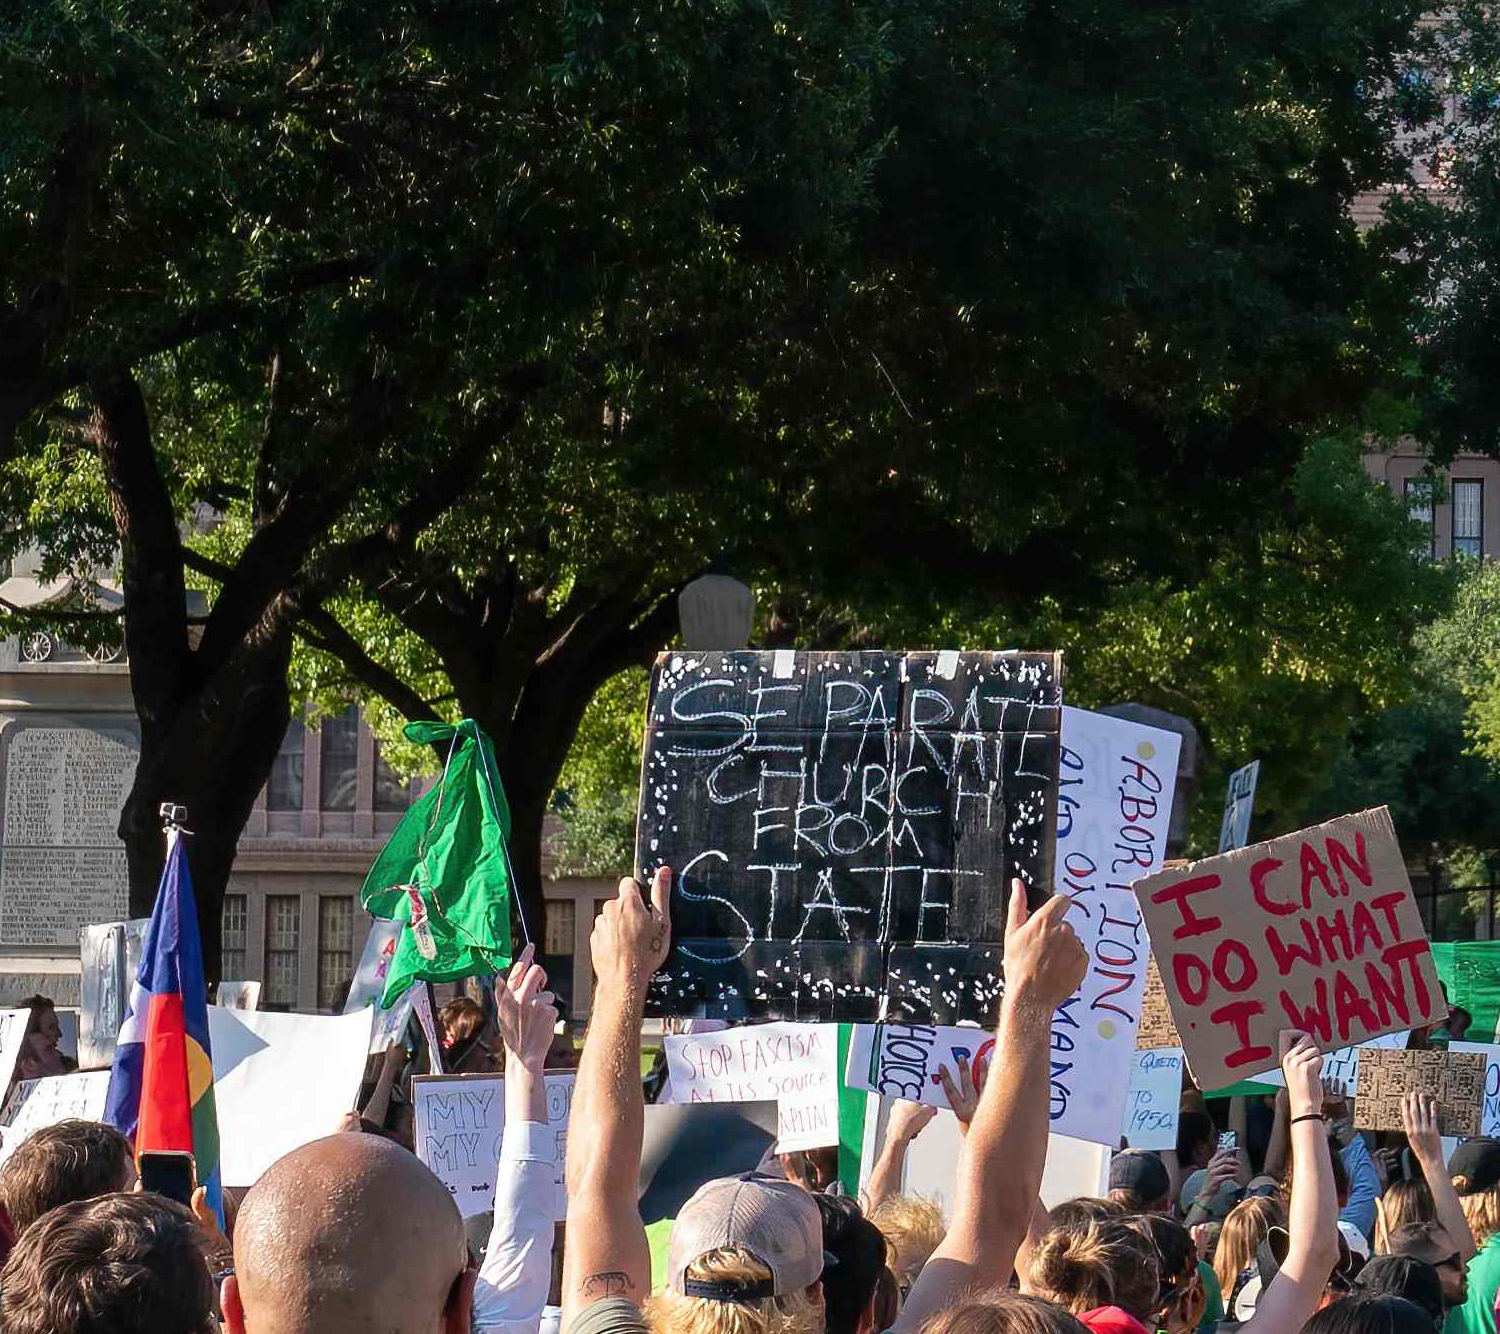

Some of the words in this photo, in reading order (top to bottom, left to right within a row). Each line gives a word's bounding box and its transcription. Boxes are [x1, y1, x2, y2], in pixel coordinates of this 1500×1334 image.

[667, 676, 1060, 789] SEPARATE
[706, 754, 998, 828] CHURCH
[753, 804, 924, 858] FROM
[676, 850, 984, 964] STATE
[1151, 874, 1221, 940] I
[1250, 831, 1372, 916] CAN
[1172, 939, 1258, 1006] DO
[1265, 891, 1406, 976] WHAT
[1210, 1000, 1272, 1067] I
[1279, 940, 1431, 1043] WANT
[682, 1043, 732, 1080] STOP
[739, 1032, 820, 1069] FASCISM
[878, 1026, 937, 1101] HOICE
[1049, 997, 1083, 1121] MAND
[426, 1089, 495, 1130] MY
[1132, 1089, 1152, 1109] TO
[426, 1132, 480, 1174] MY
